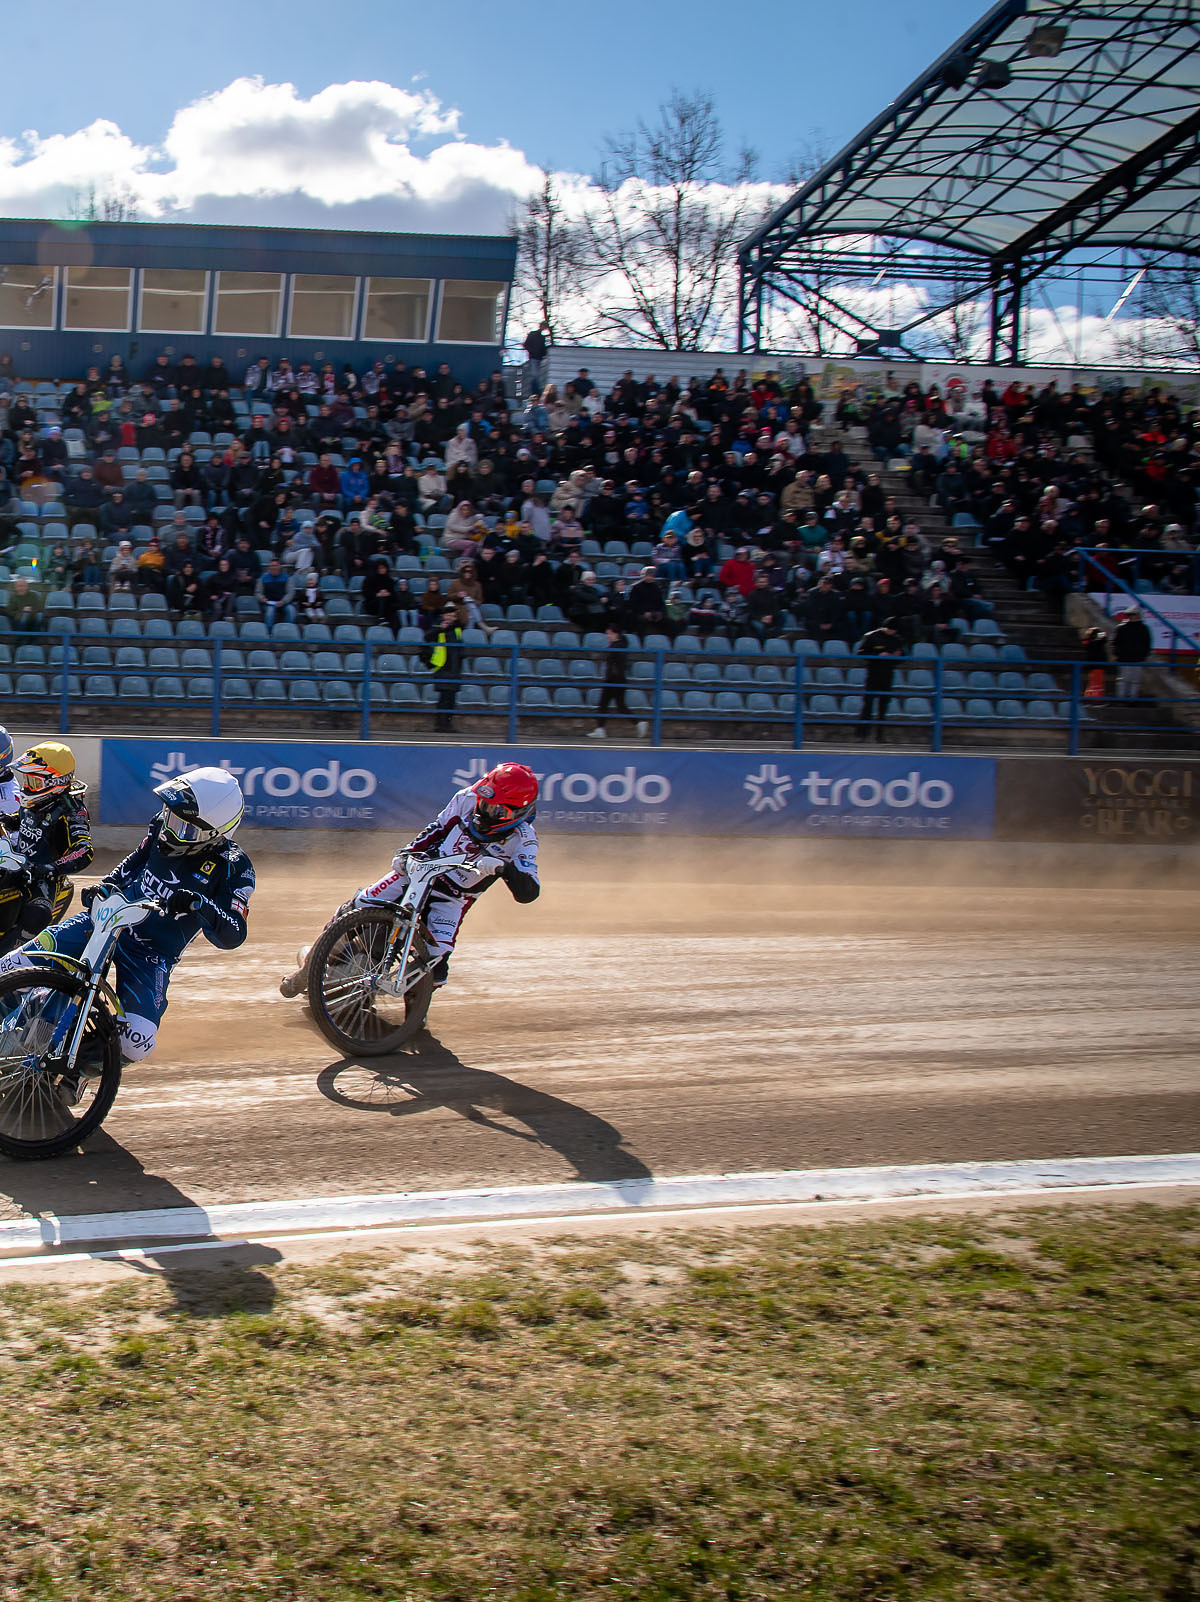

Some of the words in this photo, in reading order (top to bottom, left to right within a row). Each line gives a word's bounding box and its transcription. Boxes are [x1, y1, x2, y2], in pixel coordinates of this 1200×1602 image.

[800, 771, 955, 809] trodo
[256, 805, 309, 818] PARTS
[312, 806, 376, 819] ONLINE
